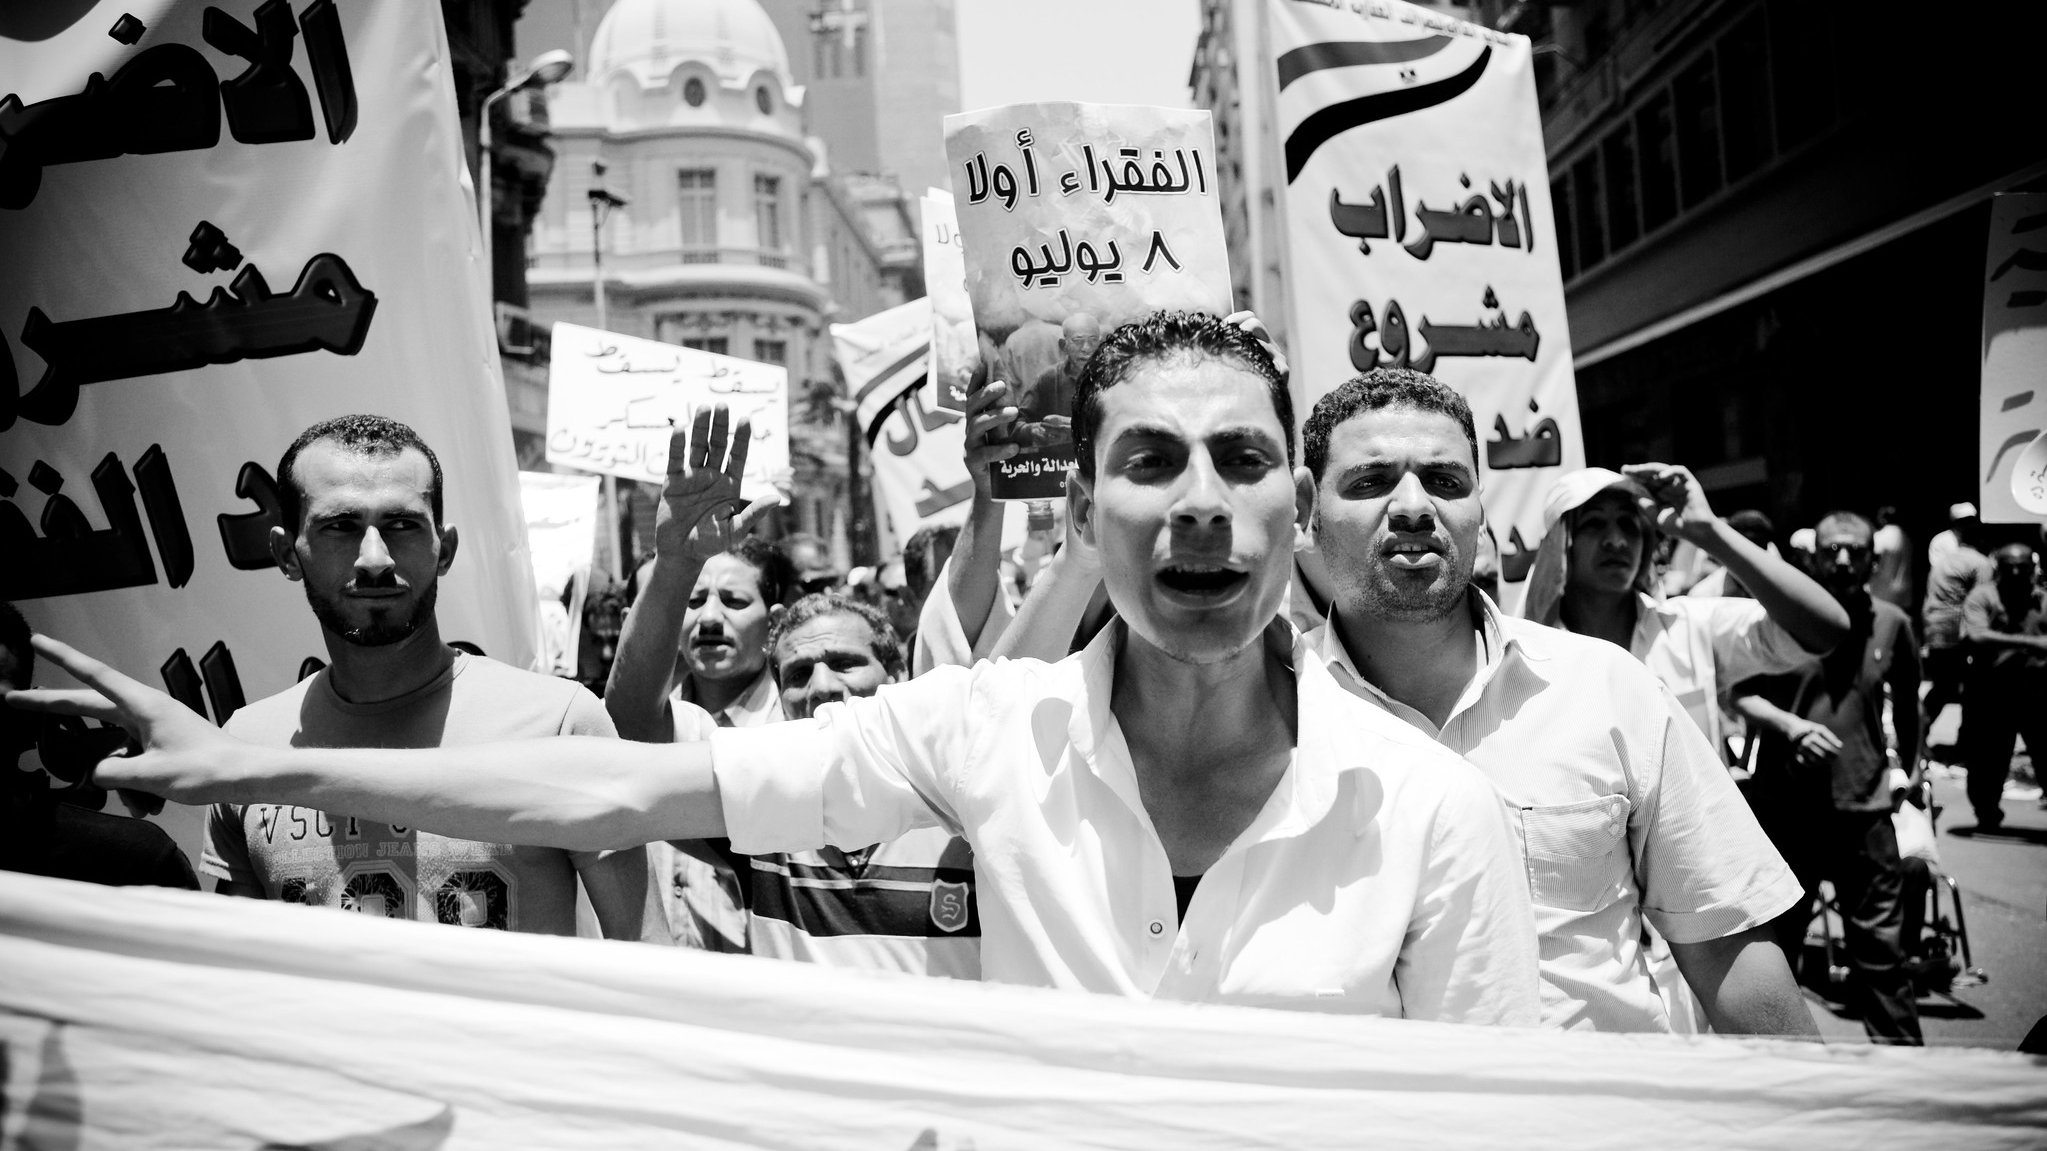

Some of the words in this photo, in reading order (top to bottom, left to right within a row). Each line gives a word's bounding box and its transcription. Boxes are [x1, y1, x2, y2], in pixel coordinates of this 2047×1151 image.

[0, 0, 359, 210] الاضر
[964, 127, 1041, 212] أولا
[1060, 144, 1208, 206] الفقراء
[1330, 163, 1535, 261] الاضراب
[1011, 228, 1125, 289] يوليو
[1142, 229, 1184, 275] ٨
[0, 220, 379, 432] مشر
[1349, 284, 1541, 374] مشروع
[1041, 457, 1080, 473] لعدالة
[1486, 397, 1562, 470] ضد
[941, 893, 961, 920] S
